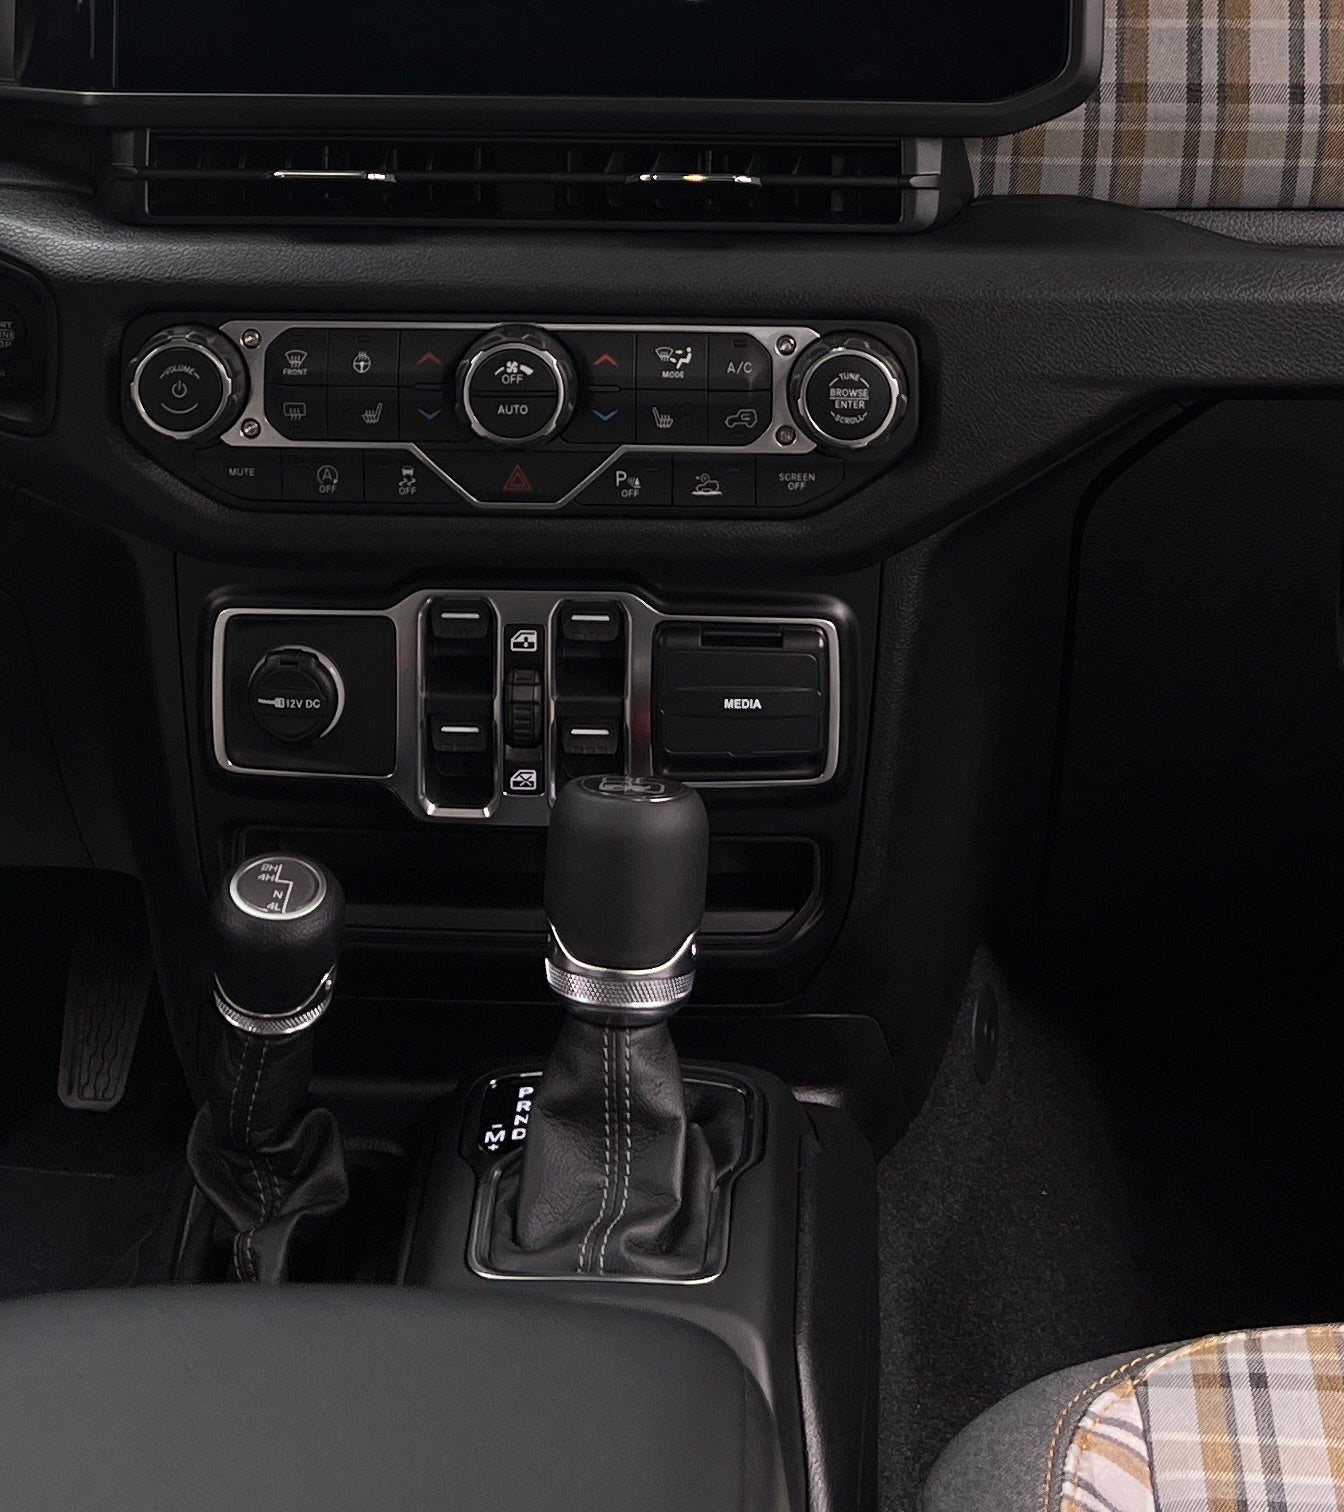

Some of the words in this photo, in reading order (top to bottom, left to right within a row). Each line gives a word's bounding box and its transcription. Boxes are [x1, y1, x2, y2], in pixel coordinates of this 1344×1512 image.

[164, 365, 196, 377] VOLUME
[282, 368, 308, 376] FRONT
[727, 361, 753, 375] A/C
[500, 374, 523, 385] OFF
[661, 371, 685, 379] MODE
[838, 372, 860, 382] TUNE
[830, 388, 869, 398] BROWSE
[835, 399, 866, 409] ENTER
[497, 404, 529, 415] AUTO
[833, 413, 865, 424] SCROLL
[228, 467, 255, 478] MUTE
[778, 472, 816, 482] SCREEN
[319, 484, 338, 494] OFF
[398, 485, 417, 495] OFF
[787, 481, 807, 491] OFF
[621, 489, 639, 499] OFF
[285, 698, 303, 710] 12V
[305, 698, 321, 710] DC
[723, 698, 762, 710] MEDIA
[257, 873, 275, 882] 4H
[272, 890, 283, 899] N
[266, 901, 281, 911] 4L
[518, 1086, 534, 1099] P
[516, 1100, 532, 1112] R
[513, 1113, 529, 1126] N
[484, 1129, 506, 1143] M
[511, 1128, 527, 1140] D
